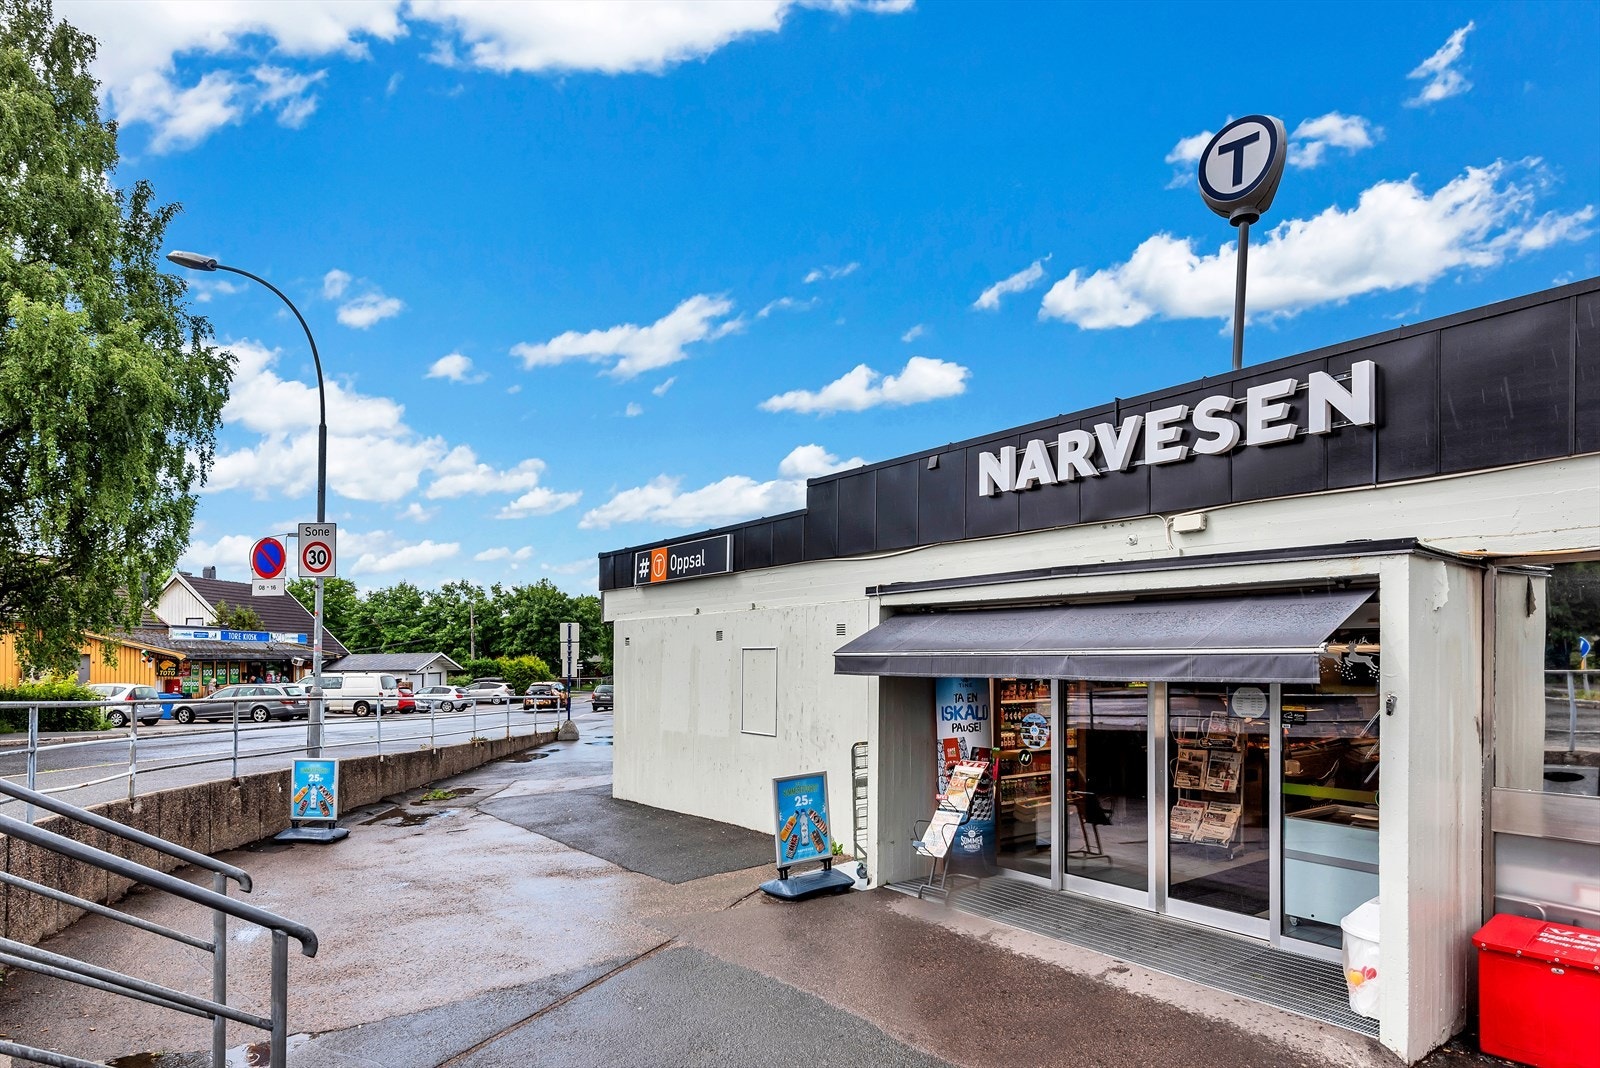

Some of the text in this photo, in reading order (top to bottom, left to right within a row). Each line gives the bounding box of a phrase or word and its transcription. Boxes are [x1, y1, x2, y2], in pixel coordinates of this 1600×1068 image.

[1218, 131, 1260, 187] T
[979, 359, 1376, 497] NARVESEN
[305, 526, 330, 537] Sone
[308, 549, 327, 566] 30
[670, 549, 705, 575] Oppsal
[228, 632, 258, 641] TORE KIOSK
[954, 692, 978, 704] TA EN
[941, 704, 989, 721] ISKALD
